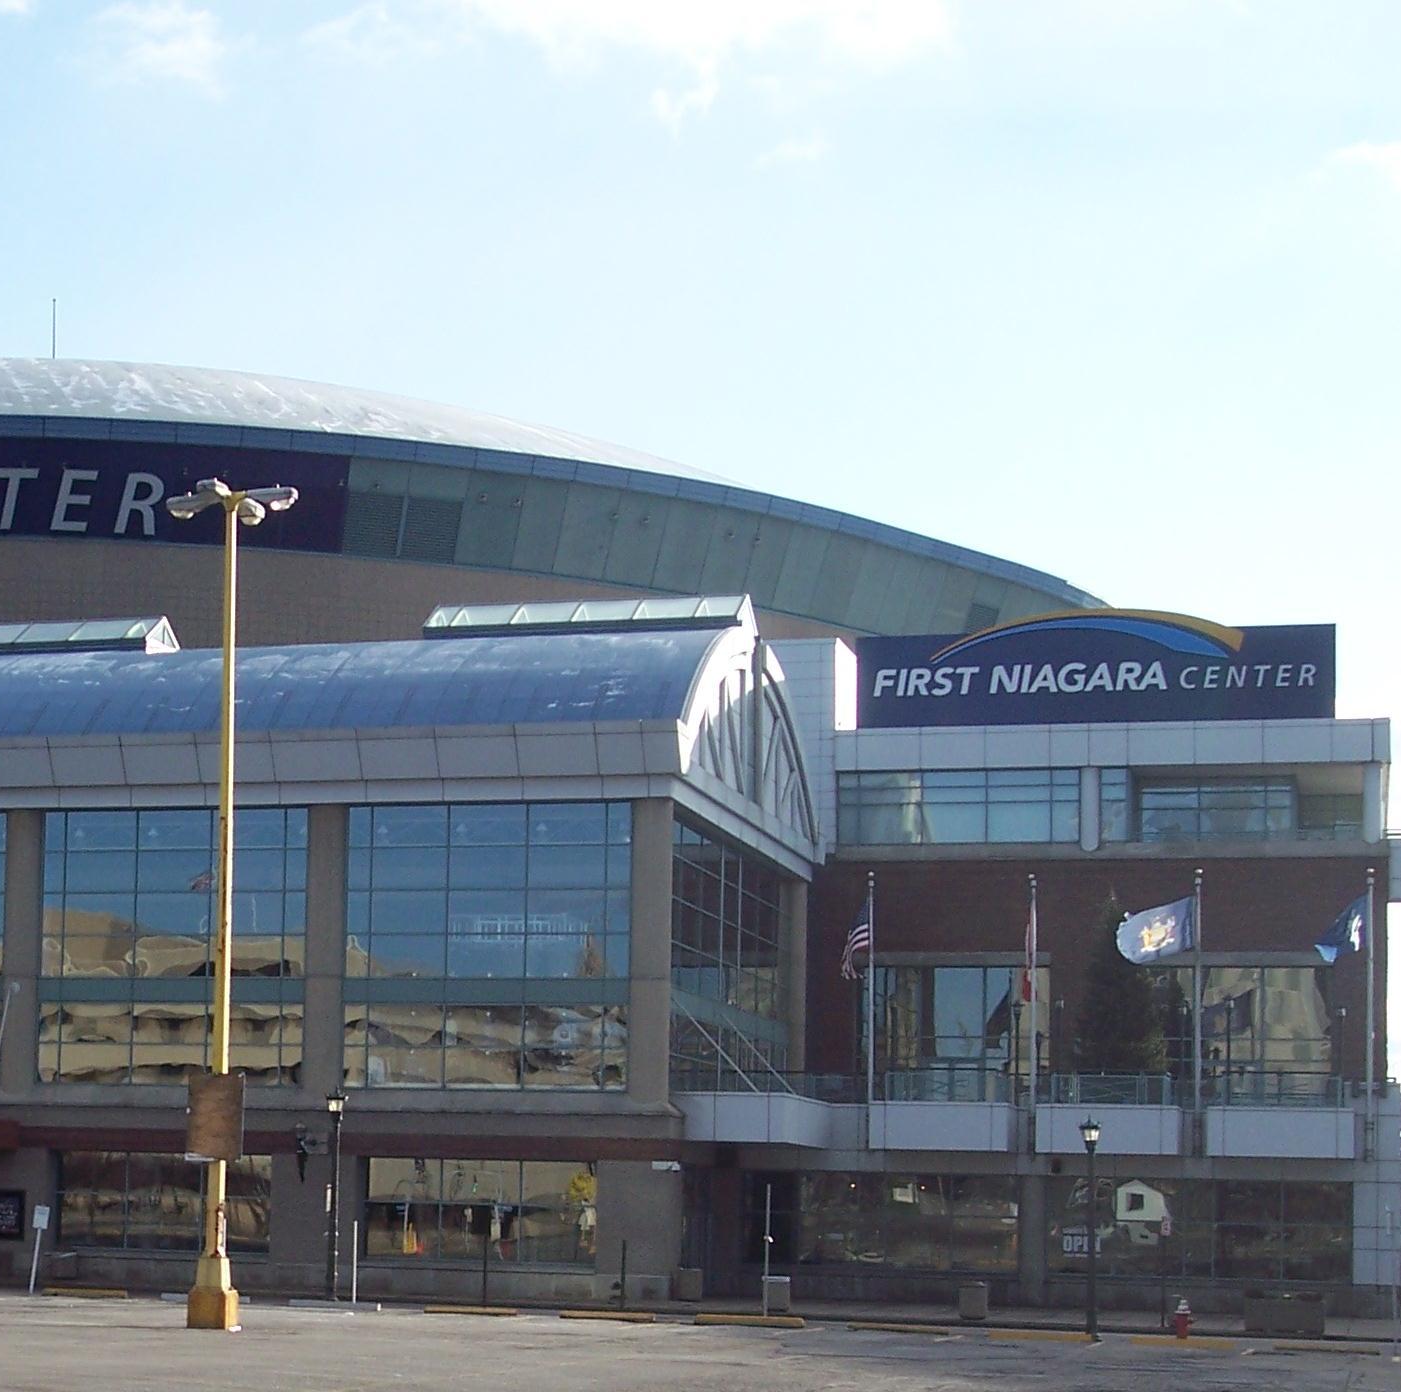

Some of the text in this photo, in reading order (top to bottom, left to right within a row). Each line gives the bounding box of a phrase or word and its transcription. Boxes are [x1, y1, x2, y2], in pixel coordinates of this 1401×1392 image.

[873, 660, 1318, 697] FIRST NIAGARA CENTER
